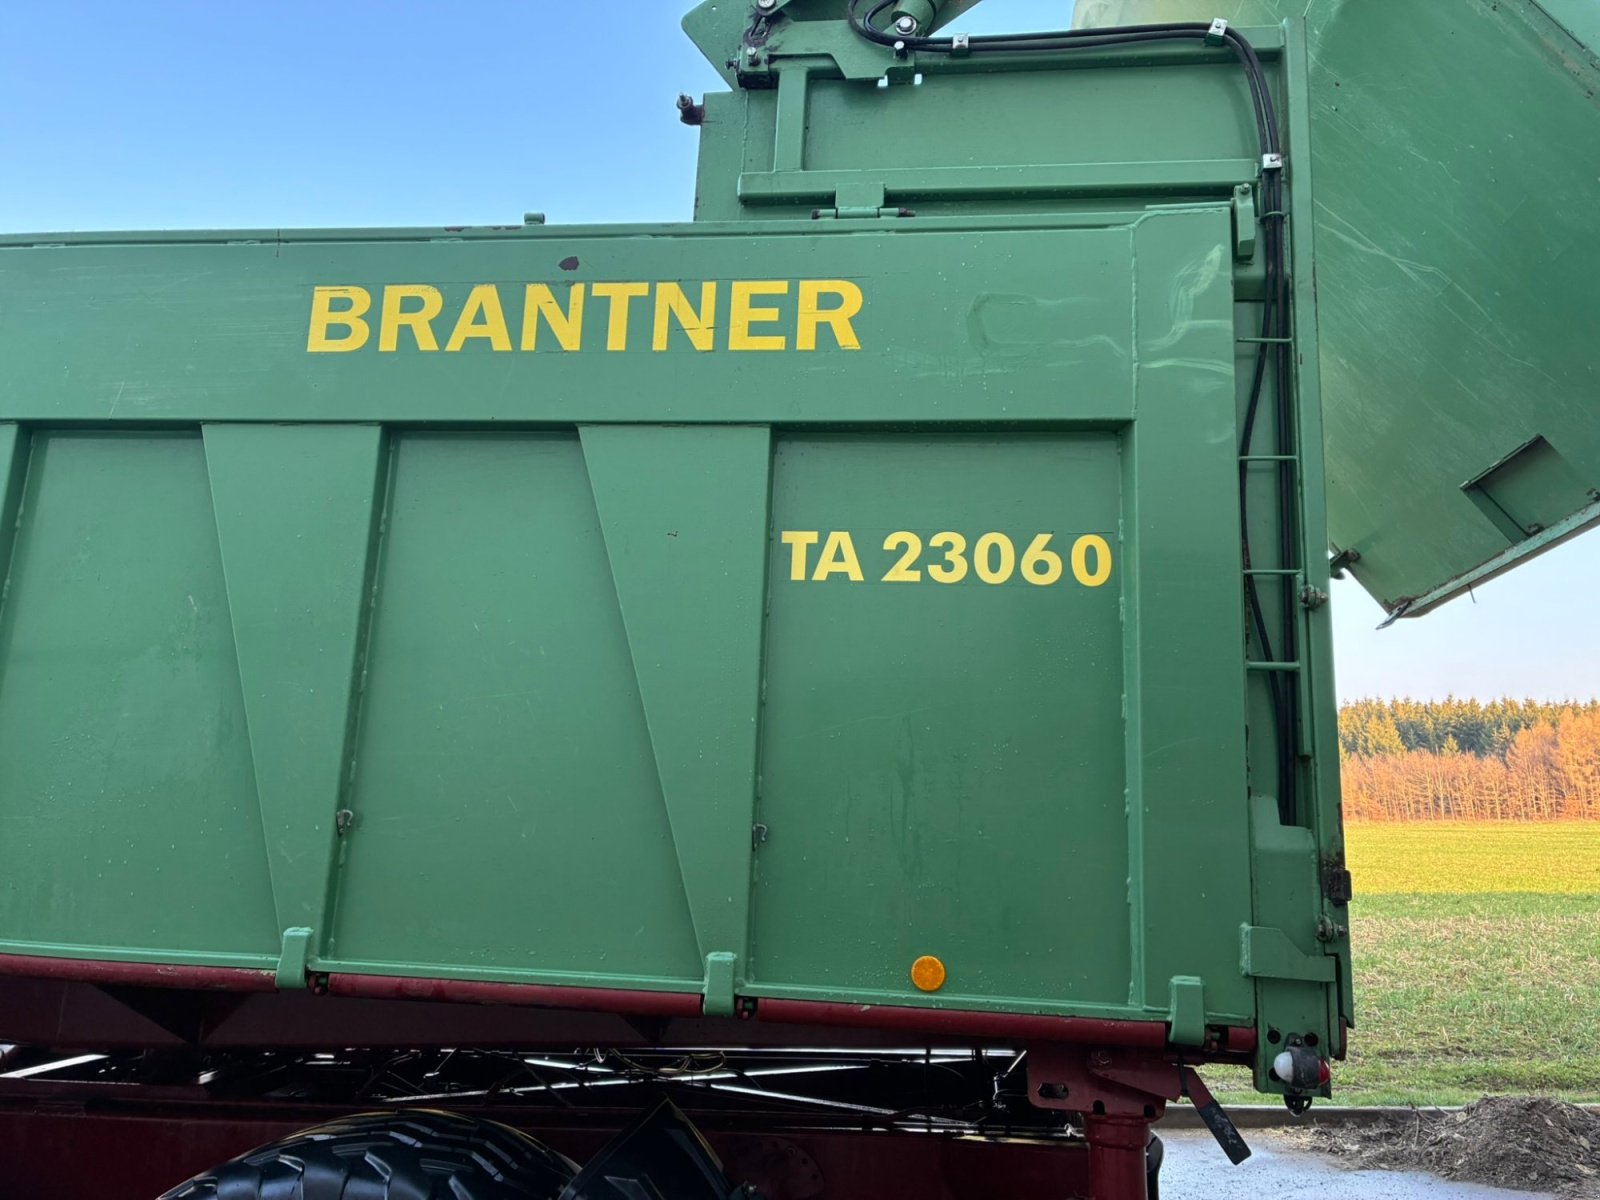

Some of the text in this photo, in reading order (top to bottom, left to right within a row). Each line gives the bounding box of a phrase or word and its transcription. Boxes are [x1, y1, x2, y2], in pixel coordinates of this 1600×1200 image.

[307, 279, 863, 353] BRANTNER
[781, 530, 1112, 587] TA 23060
